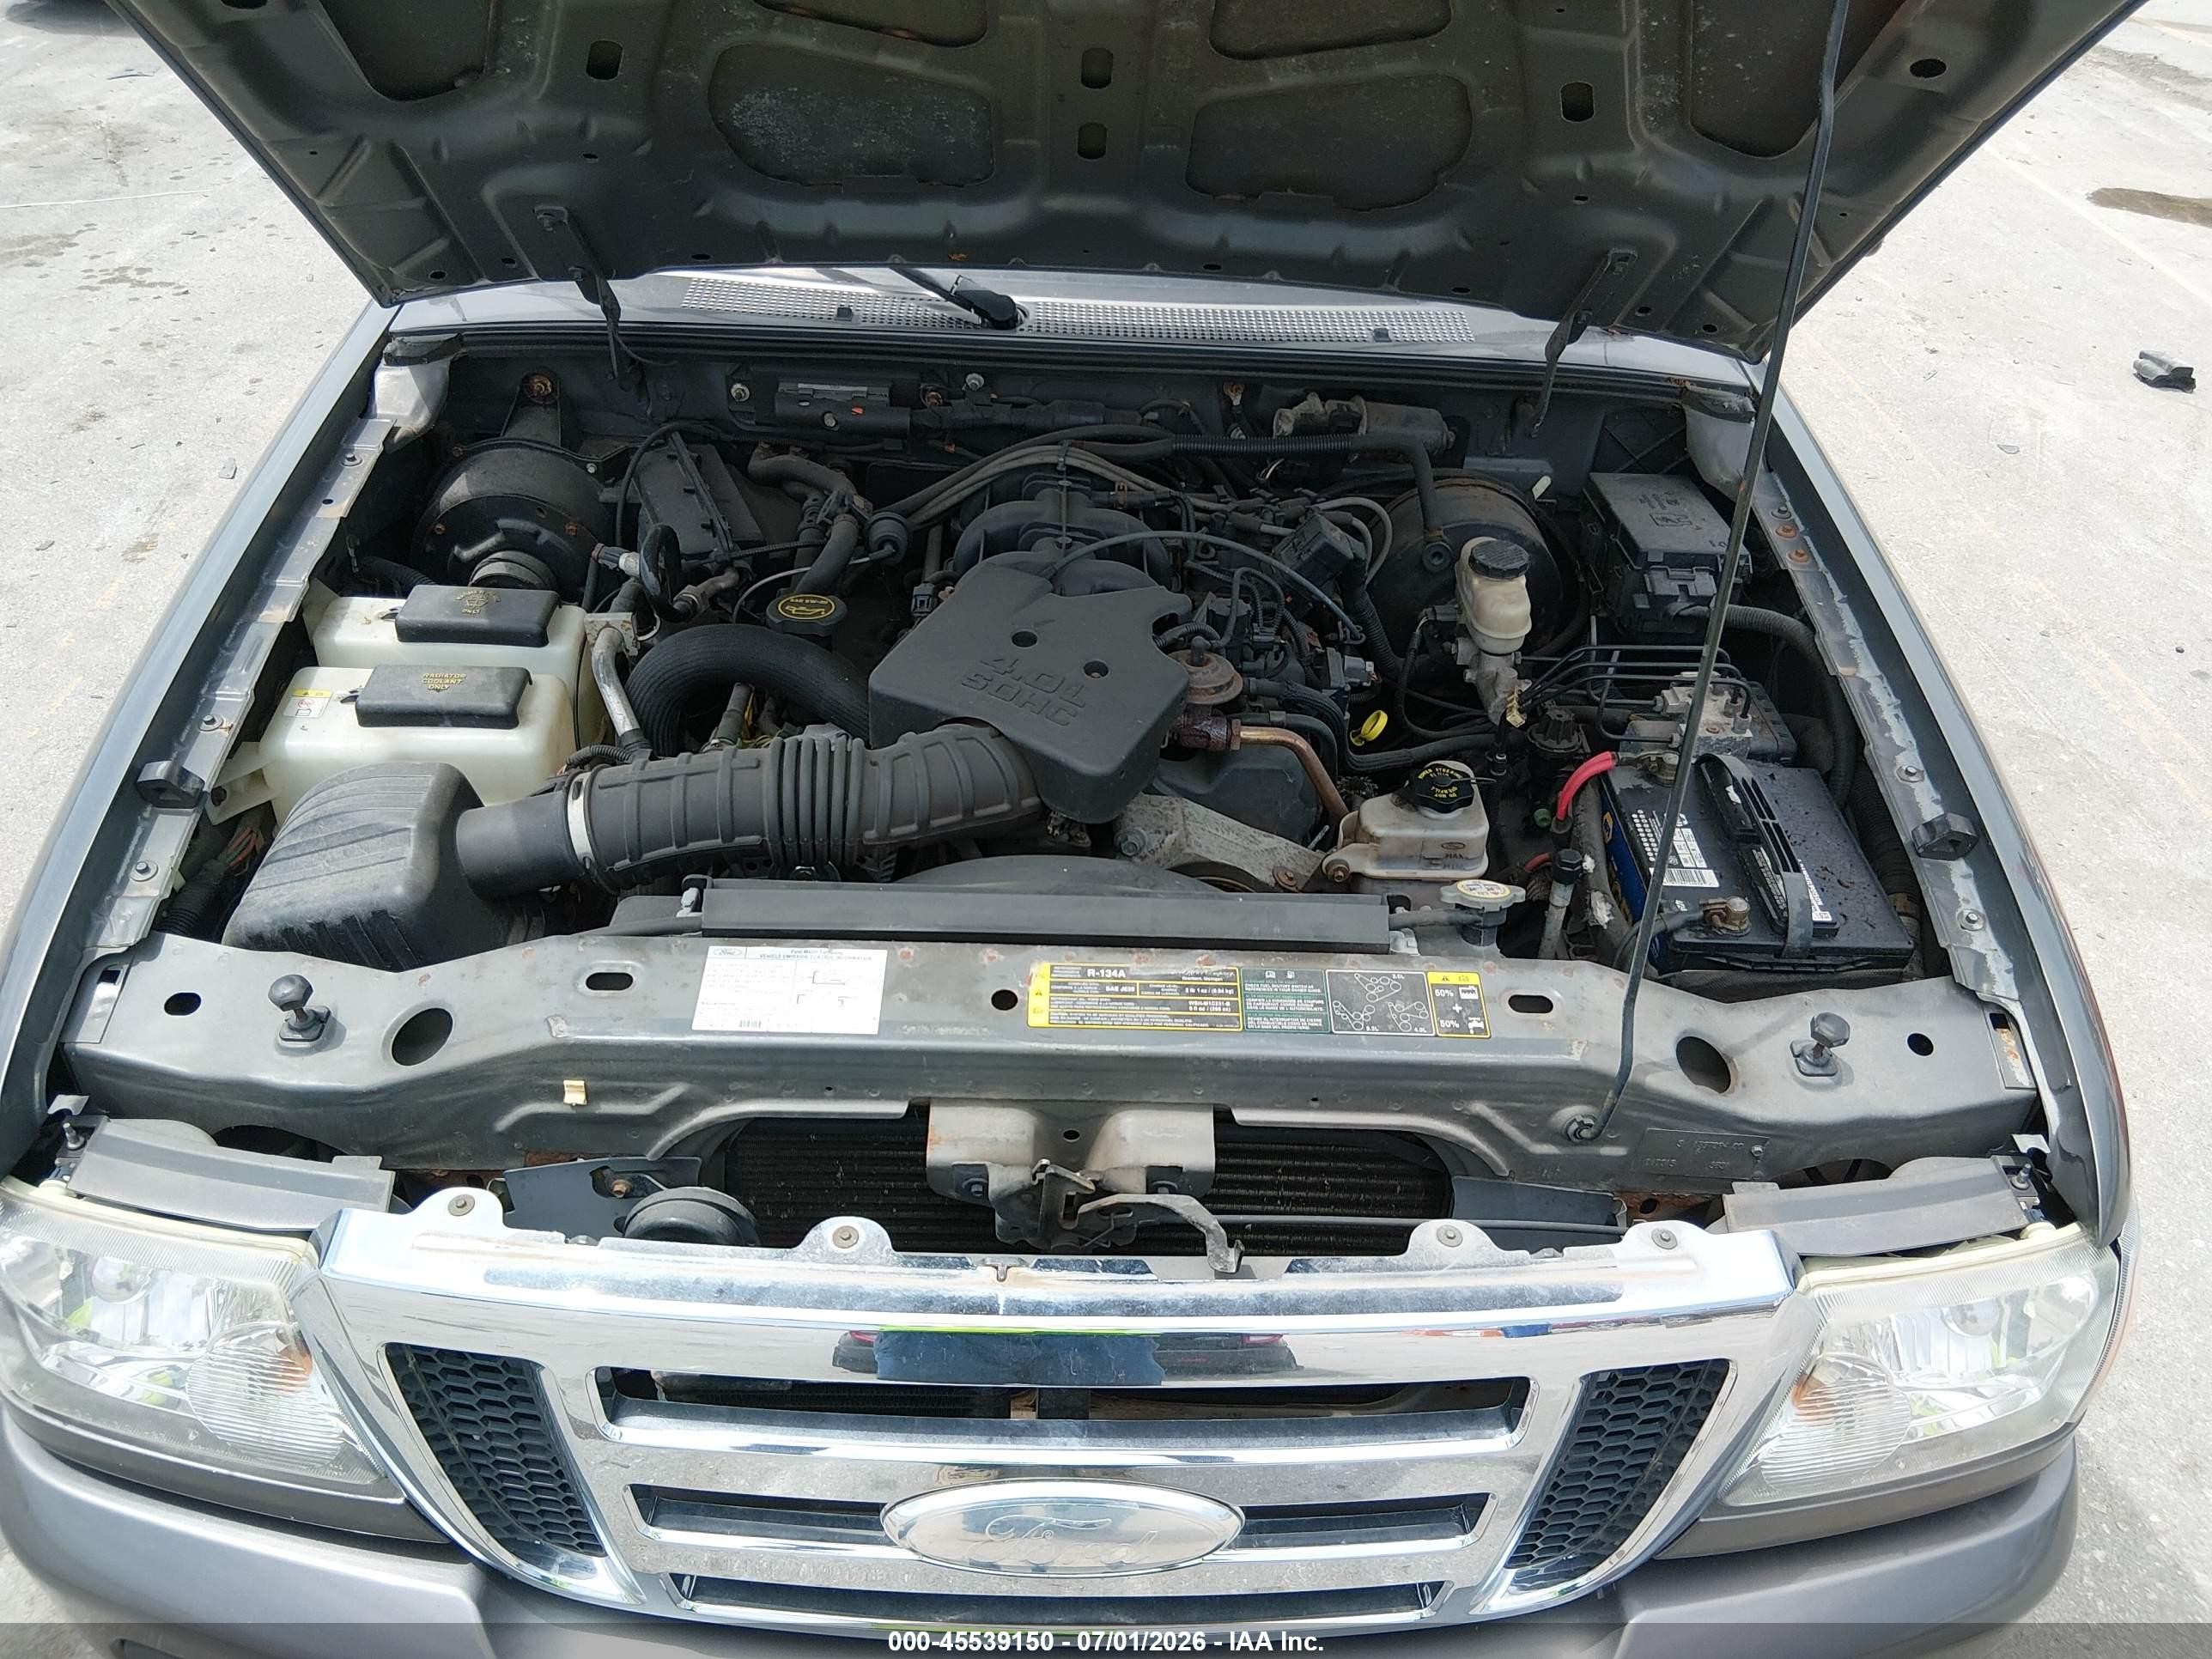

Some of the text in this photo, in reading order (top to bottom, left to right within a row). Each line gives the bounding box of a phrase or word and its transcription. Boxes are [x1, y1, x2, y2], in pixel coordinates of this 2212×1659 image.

[980, 658, 1086, 708] 4.0L
[962, 673, 1078, 726] SOHC
[1087, 969, 1126, 978] R-134A
[1434, 988, 1455, 997] 50%
[1439, 1019, 1460, 1029] 50%
[968, 1514, 1158, 1565] Ford
